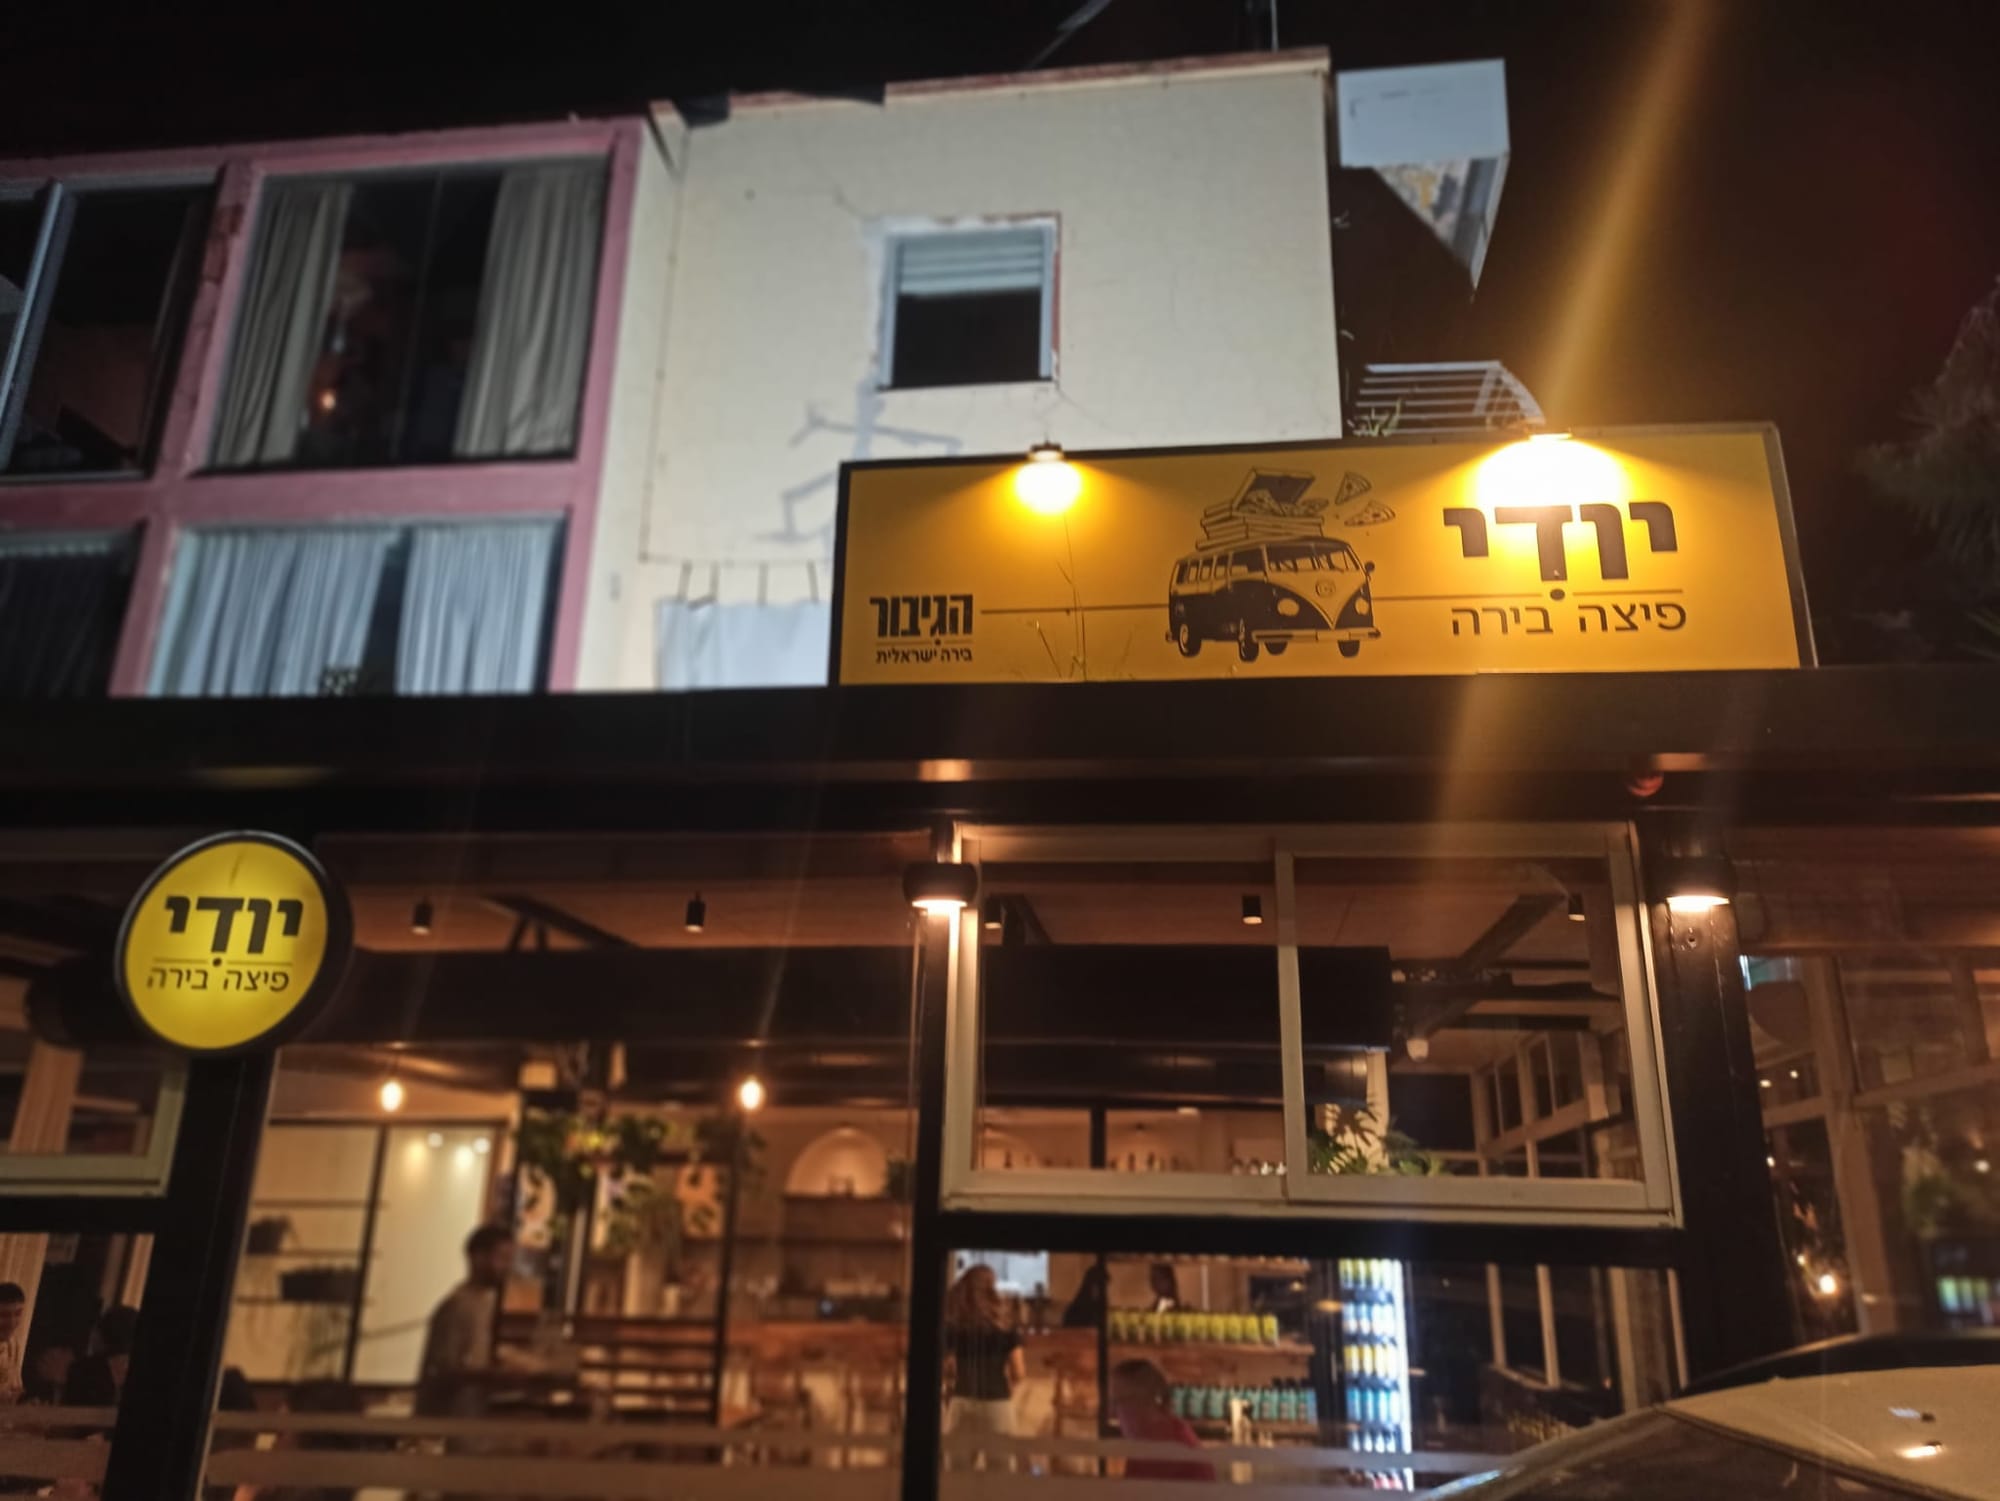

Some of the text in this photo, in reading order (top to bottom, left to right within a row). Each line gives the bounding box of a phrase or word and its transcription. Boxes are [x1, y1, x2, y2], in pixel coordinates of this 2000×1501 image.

[1451, 603, 1687, 636] פיצה בירה
[876, 648, 973, 664] בירה ישראלית
[146, 968, 290, 993] פיצה בירה
